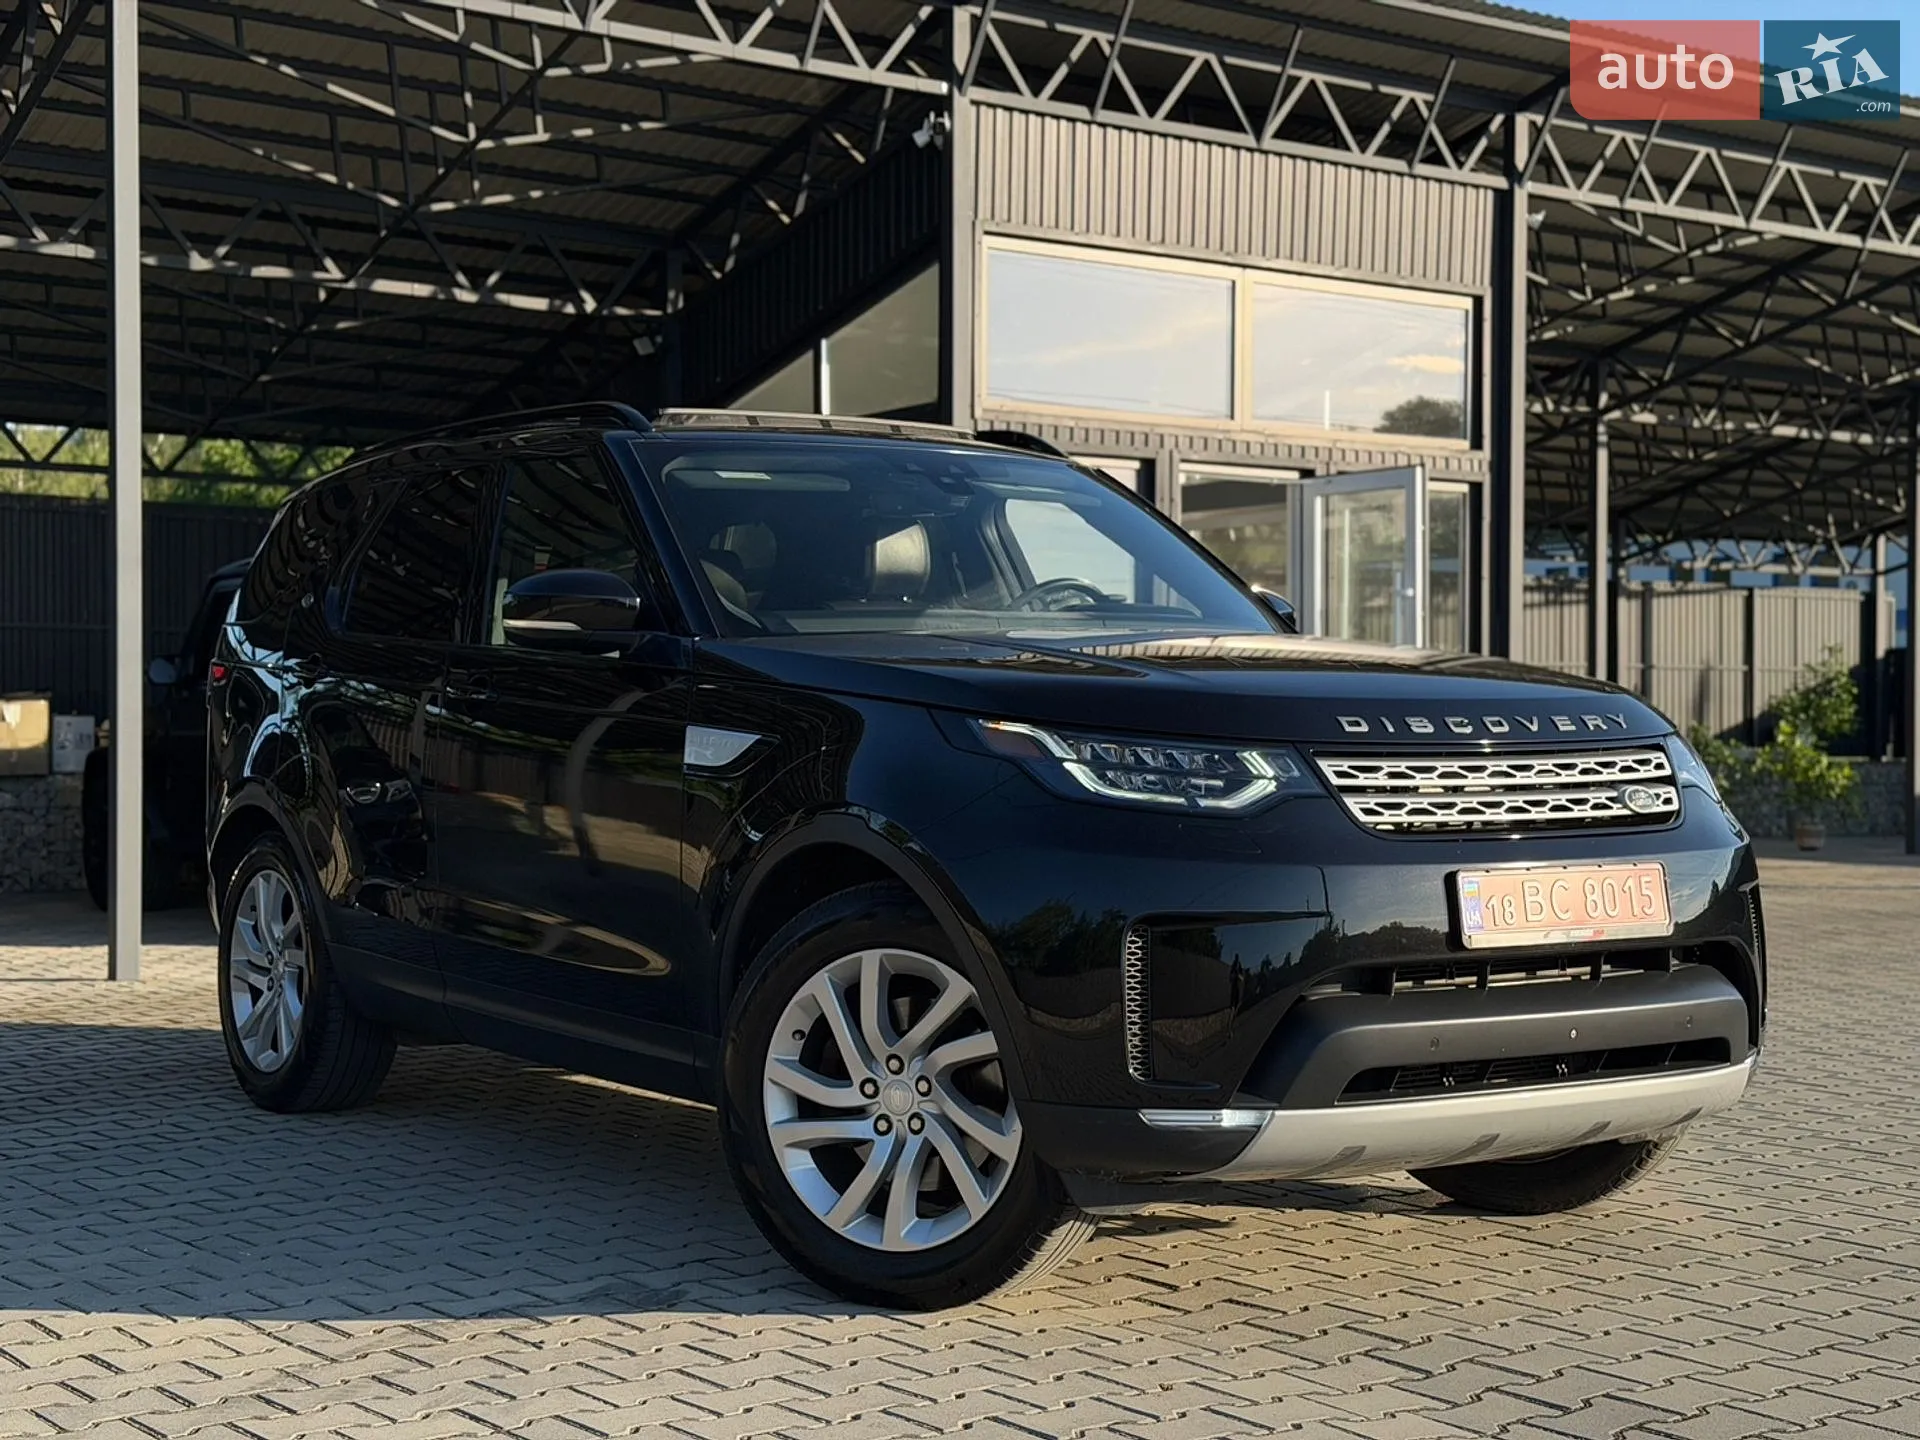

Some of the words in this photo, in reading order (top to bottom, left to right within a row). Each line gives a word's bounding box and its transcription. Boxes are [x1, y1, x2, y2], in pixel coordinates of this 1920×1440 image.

[1336, 714, 1628, 734] DISCOVERY
[1486, 895, 1517, 927] 18
[1522, 879, 1572, 922] BC
[1582, 875, 1656, 919] 8015
